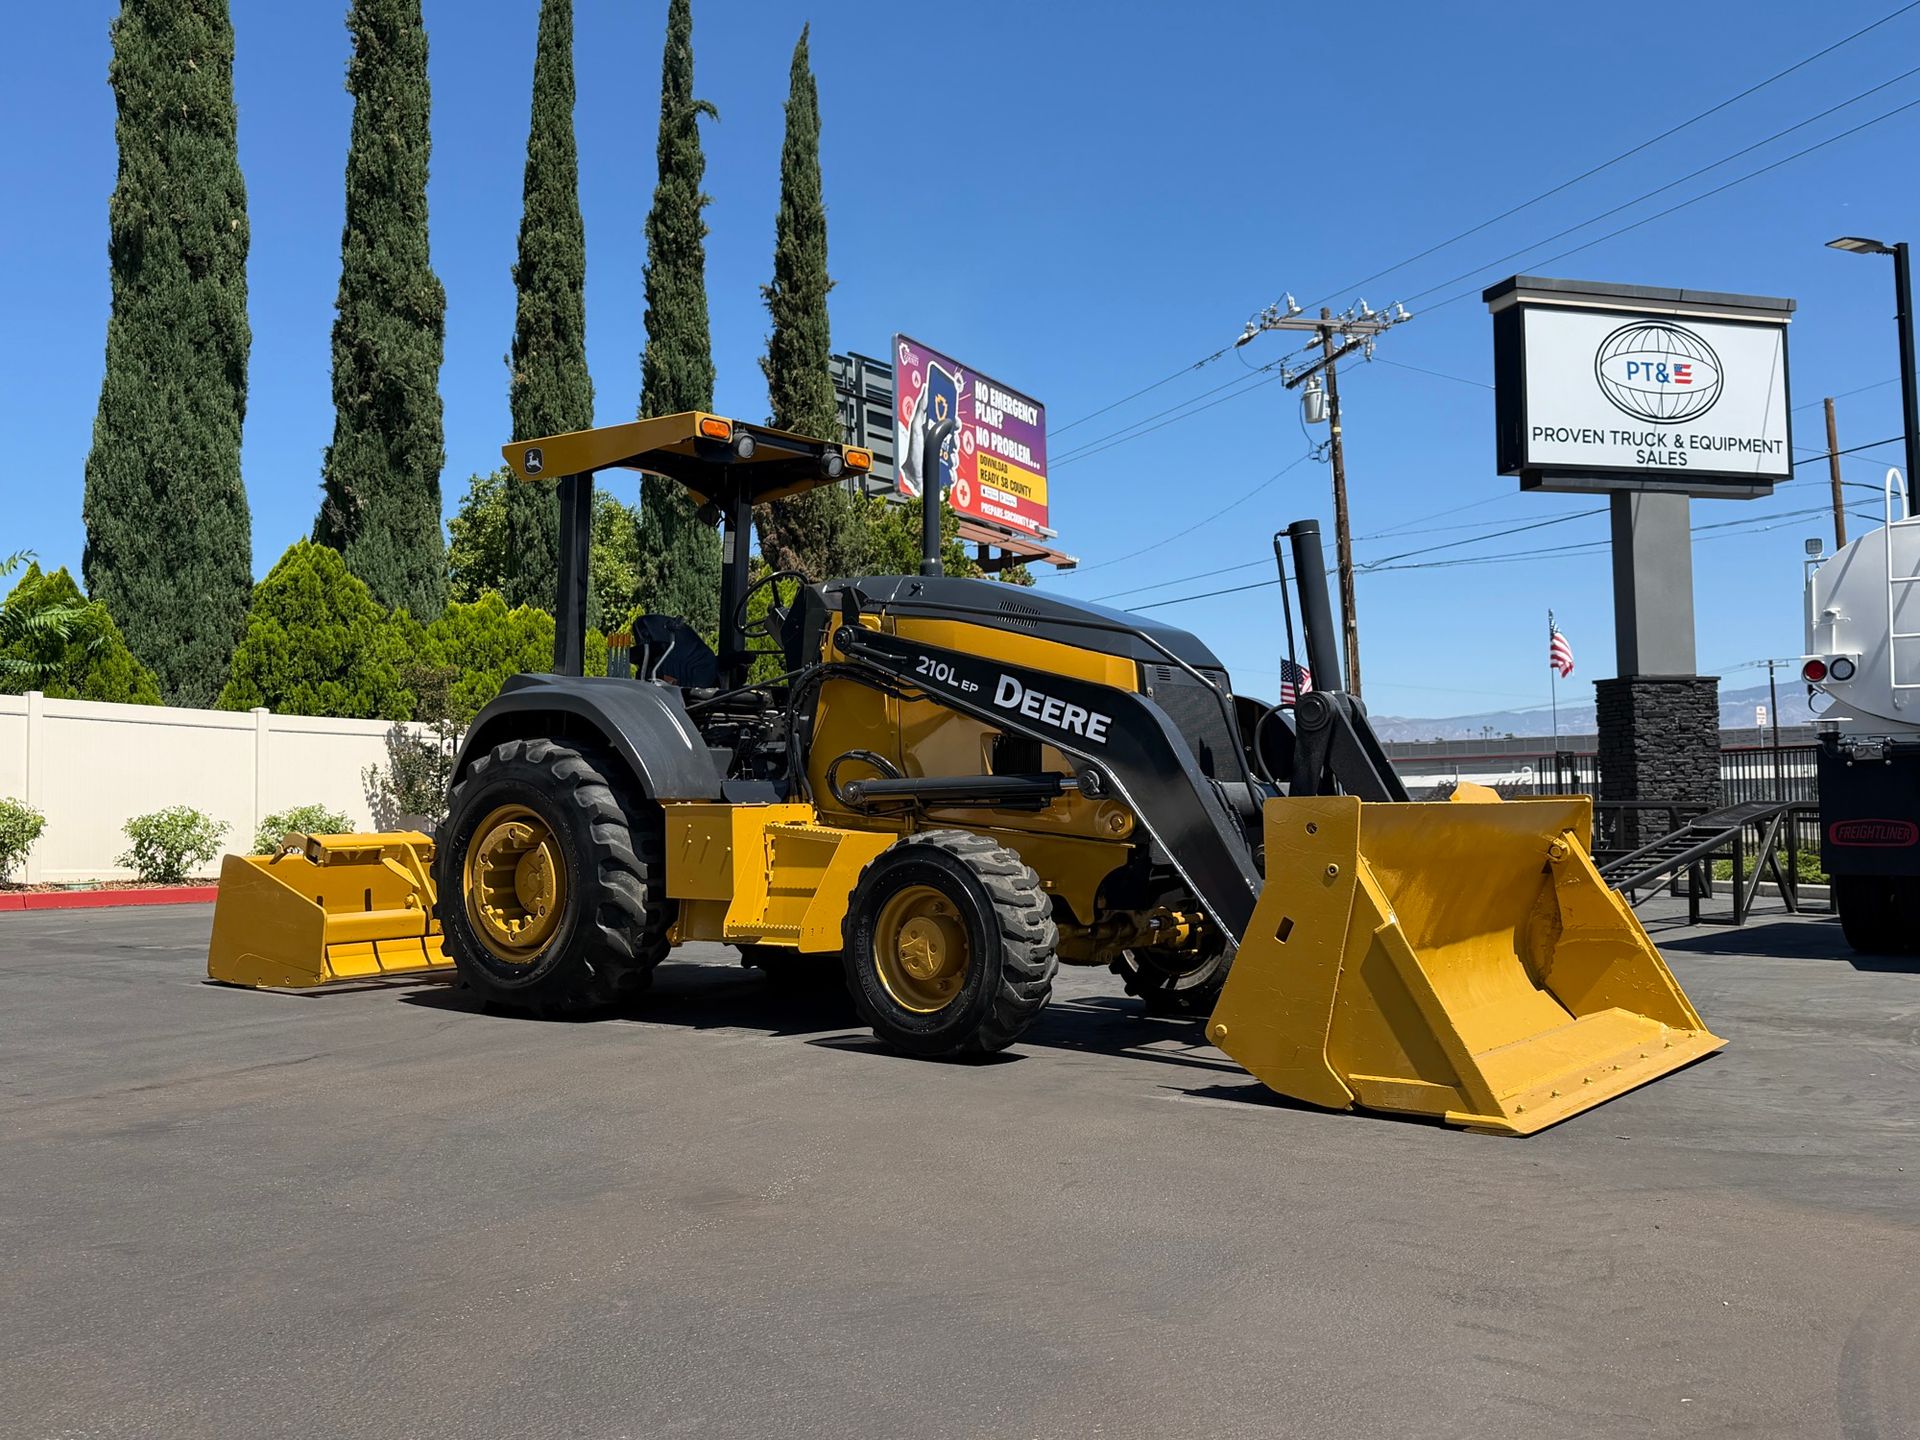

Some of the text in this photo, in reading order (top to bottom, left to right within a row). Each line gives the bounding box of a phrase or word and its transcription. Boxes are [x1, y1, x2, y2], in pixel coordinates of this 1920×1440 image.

[975, 380, 1038, 427] NO EMERGENCY
[975, 400, 1004, 430] PLAN?
[975, 425, 1041, 470] NO PROBLEM...
[1532, 427, 1783, 454] PROVEN TRUCK & EQUIPMENT
[980, 454, 1008, 474] DOWNLOAD
[1636, 449, 1688, 466] SALES
[980, 468, 1000, 486] READY
[1001, 476, 1009, 489] SB
[1009, 480, 1032, 498] COUNTY
[916, 655, 1112, 744] 210L EP DEERE
[1838, 824, 1910, 841] FREIGHTLINER
